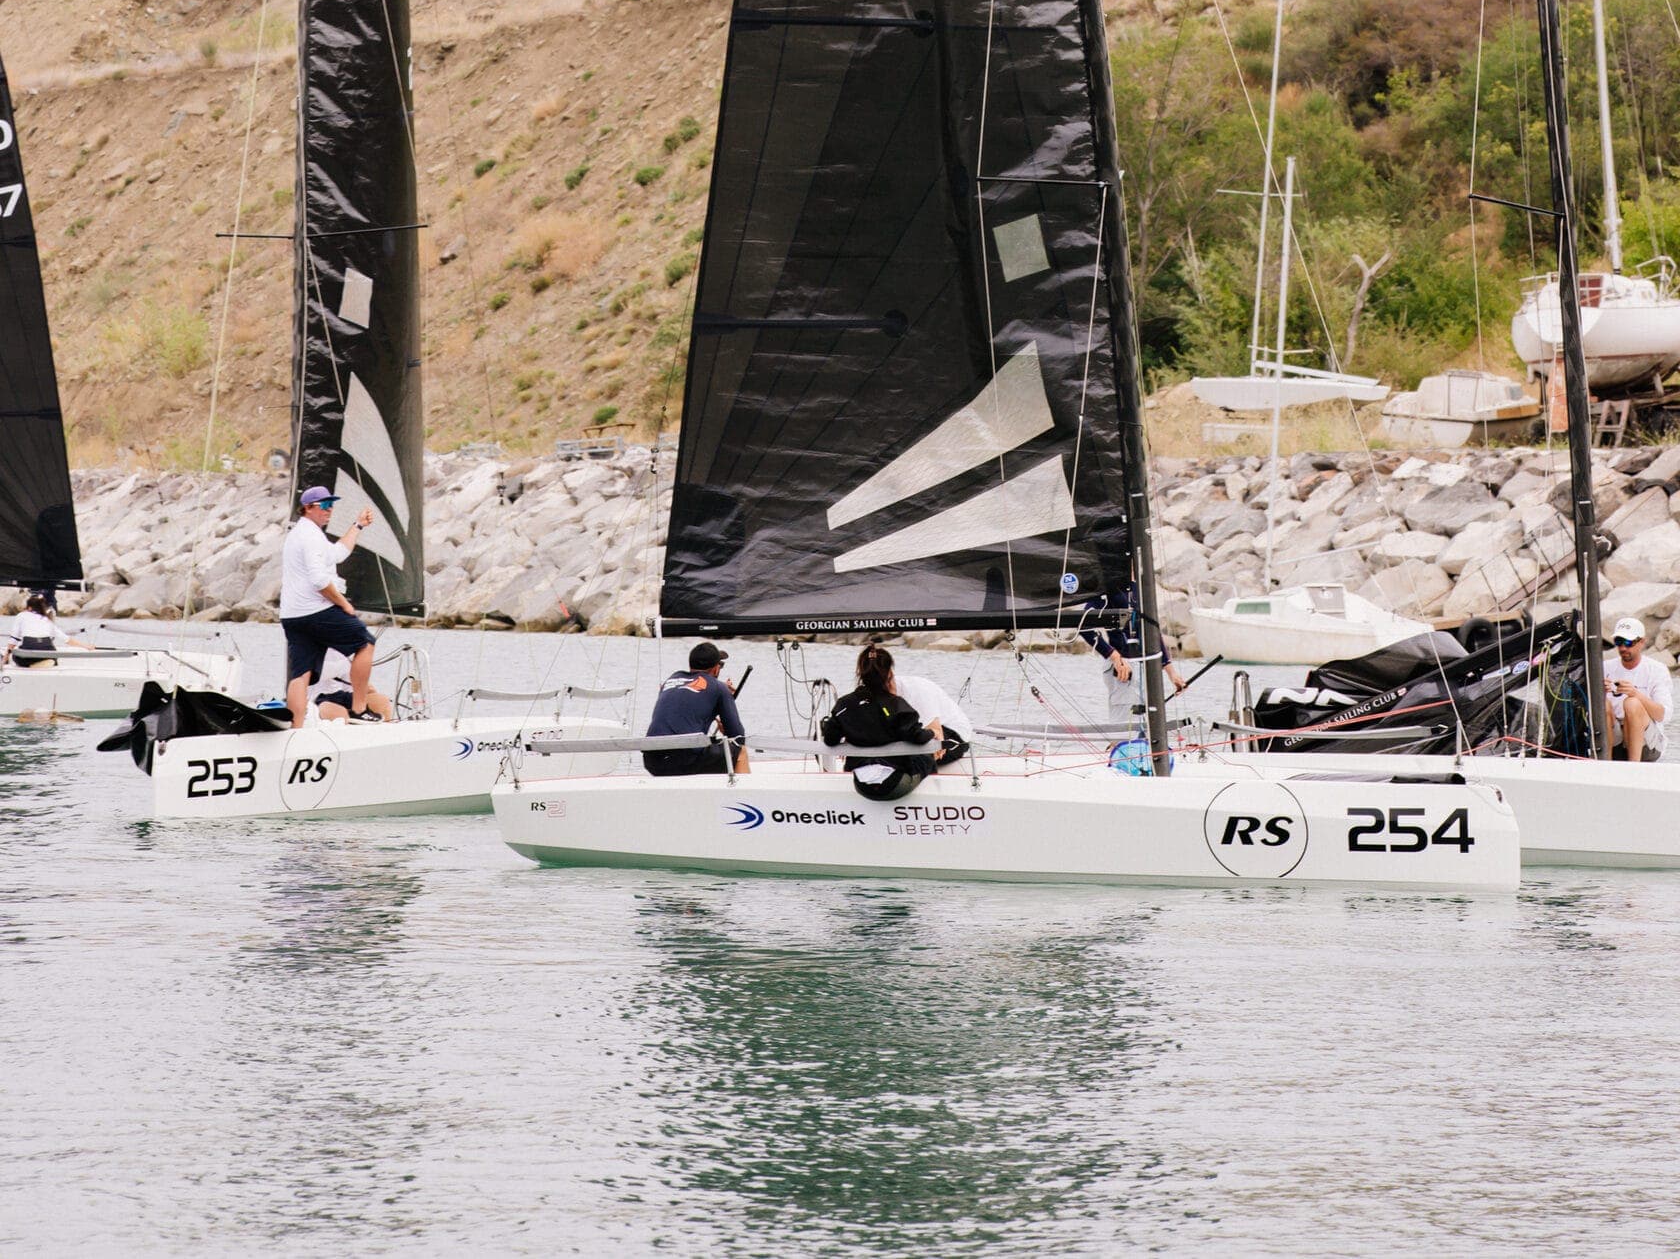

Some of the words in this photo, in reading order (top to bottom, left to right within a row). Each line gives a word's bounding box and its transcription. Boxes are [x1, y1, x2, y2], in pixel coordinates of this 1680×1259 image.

[796, 620, 850, 630] GEORGIAN
[853, 619, 895, 629] SAILING
[897, 618, 924, 628] CLUB
[1334, 702, 1372, 725] SAILING
[1372, 691, 1397, 709] CLUB
[187, 756, 257, 798] 253
[287, 756, 332, 784] RS
[771, 810, 866, 825] Oneclick
[894, 806, 985, 821] STUDIO
[887, 824, 971, 835] LIBERTY
[1221, 816, 1294, 847] RS
[1347, 808, 1475, 853] 254
